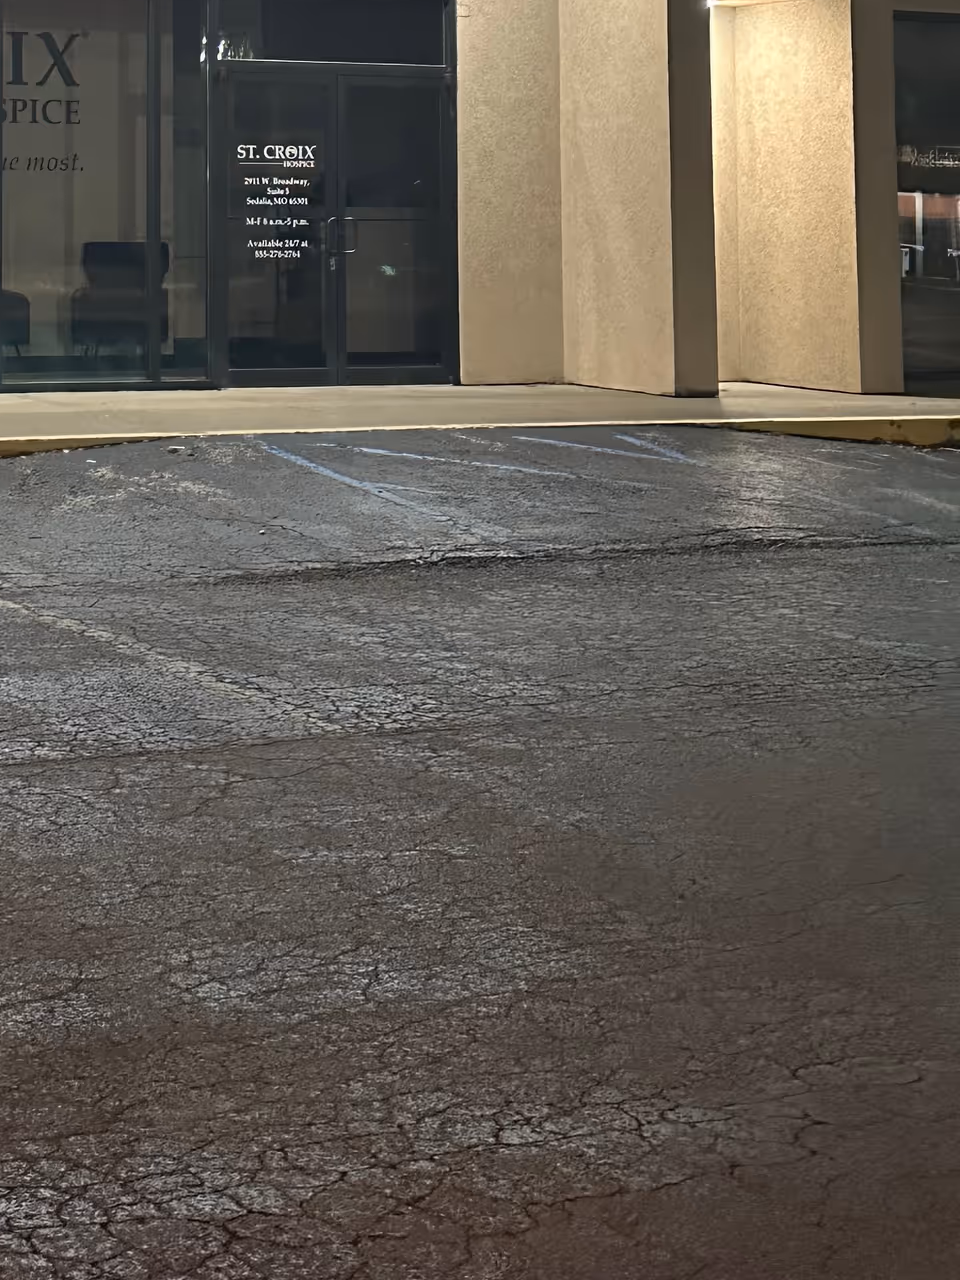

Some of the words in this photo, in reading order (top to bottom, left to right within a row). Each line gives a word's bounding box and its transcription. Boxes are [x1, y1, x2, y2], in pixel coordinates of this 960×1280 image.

[236, 144, 260, 159] ST.
[263, 144, 317, 160] CROIX
[26, 152, 85, 173] most.
[283, 160, 315, 168] HOSPICE
[273, 196, 288, 205] MO
[247, 239, 284, 248] Available
[300, 239, 309, 248] at
